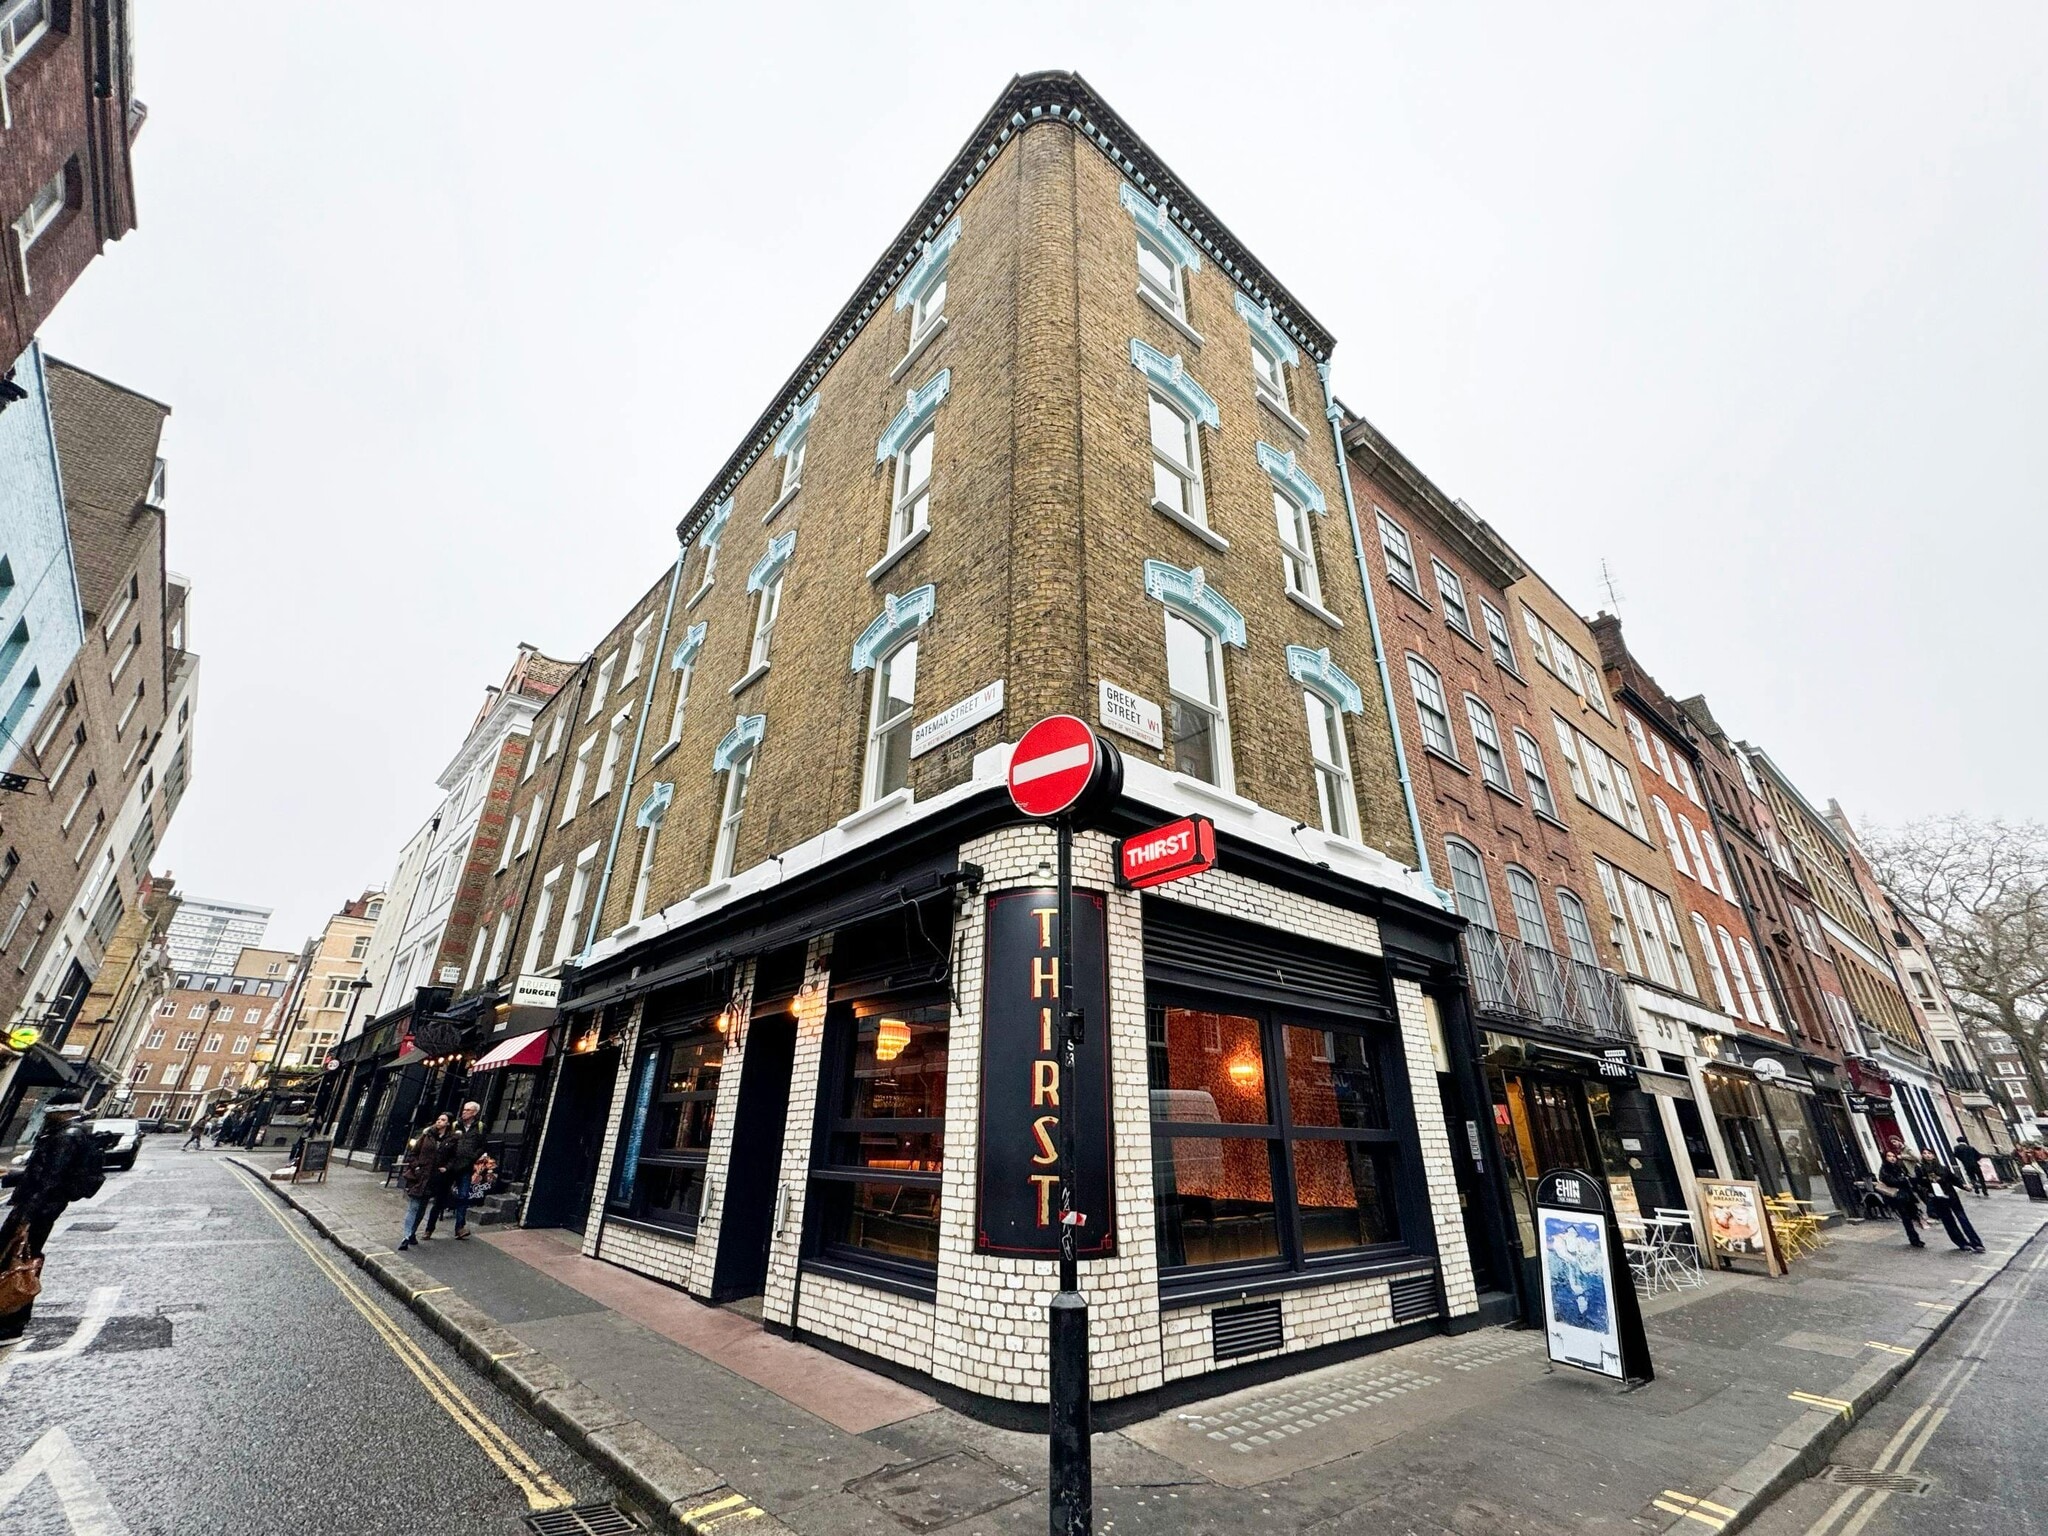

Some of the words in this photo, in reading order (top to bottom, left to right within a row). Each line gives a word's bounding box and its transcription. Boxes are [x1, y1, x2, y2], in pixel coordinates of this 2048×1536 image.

[1106, 687, 1137, 711] GREEK
[915, 713, 949, 742] BATEMAN
[950, 696, 980, 722] STREET
[983, 687, 997, 703] W1
[1107, 700, 1142, 725] STREET
[1147, 718, 1160, 734] W1
[1126, 831, 1191, 867] THIRST
[519, 987, 557, 998] BURGER
[520, 979, 559, 990] TRUFFLE
[1655, 1016, 1673, 1040] 55
[1030, 908, 1061, 1228] THIRST
[1599, 1063, 1627, 1077] CHIN
[1555, 1178, 1580, 1189] CHIN
[1556, 1187, 1581, 1199] CHIN
